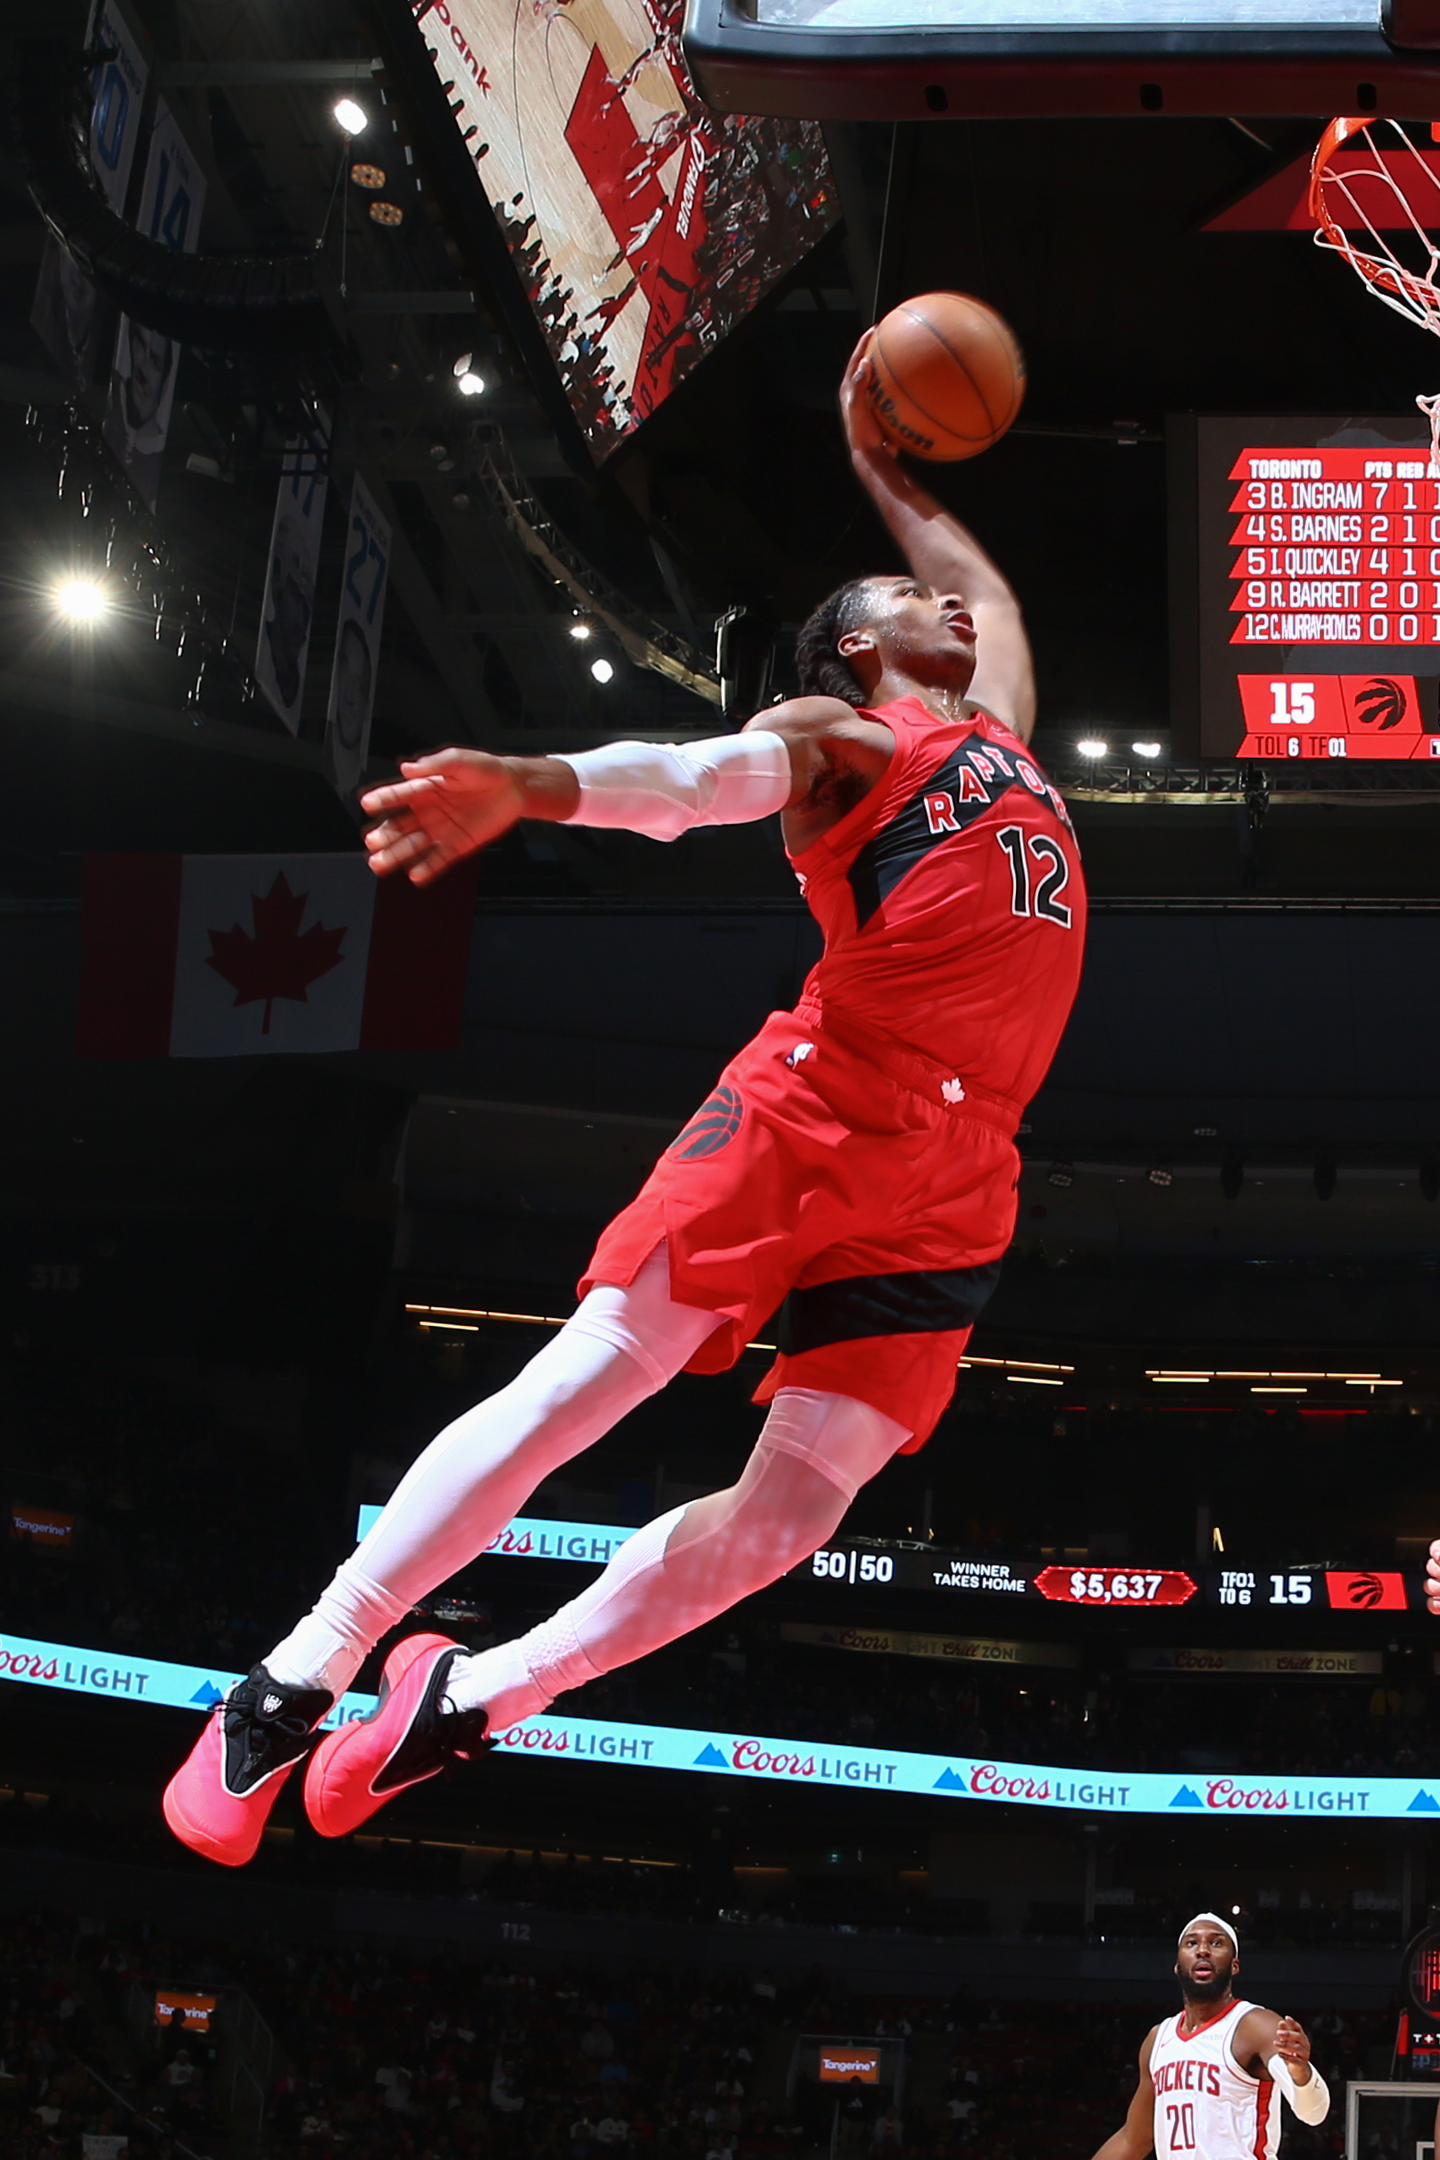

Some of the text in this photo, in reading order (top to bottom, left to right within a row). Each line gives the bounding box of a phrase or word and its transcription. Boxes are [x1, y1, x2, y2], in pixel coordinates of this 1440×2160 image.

[1249, 459, 1323, 479] TORONTO
[1364, 461, 1393, 479] PTS
[1397, 461, 1424, 479] REB
[1247, 482, 1266, 510] 3
[1271, 482, 1287, 510] B.
[1291, 482, 1363, 510] INGRAM
[1370, 482, 1388, 510] 7
[1402, 482, 1418, 510] 1
[1246, 515, 1266, 542] 4
[1270, 515, 1287, 542] S.
[1291, 515, 1362, 542] BARNES
[1370, 515, 1389, 542] 2
[1402, 515, 1418, 542] 1
[1248, 548, 1266, 575] 5
[1270, 548, 1284, 575] I.
[1285, 548, 1361, 579] QUICKLEY
[1369, 548, 1389, 575] 4
[1402, 548, 1417, 575] 1
[1247, 581, 1266, 608] 9
[1270, 581, 1286, 608] R.
[1289, 581, 1362, 608] BARRETT
[1370, 581, 1388, 608] 2
[1400, 581, 1418, 608] 0
[1245, 613, 1269, 640] 12
[1270, 613, 1280, 640] C.
[1369, 613, 1388, 640] 0
[1400, 613, 1418, 640] 0
[1269, 682, 1315, 724] 15
[1255, 736, 1284, 756] TOL
[1287, 737, 1300, 757] 6
[923, 745, 1074, 846] RAPTOR
[996, 825, 1072, 930] 12
[13, 1516, 66, 1536] Tangerine
[539, 1533, 624, 1561] LIGH
[933, 1572, 1026, 1592] TAKES HOME
[950, 1561, 1011, 1578] WINNER
[1070, 1571, 1163, 1603] $5,637
[1238, 1589, 1252, 1605] 6
[1268, 1575, 1313, 1604] 15
[838, 1629, 890, 1651] Coors
[942, 1643, 979, 1658] Chill
[0, 1648, 150, 1694] oors LIGHT
[1174, 1650, 1224, 1669] Coors
[1276, 1655, 1315, 1671] Chill
[1316, 1658, 1358, 1672] ZONE
[503, 1727, 655, 1761] oors LIGHT
[732, 1740, 898, 1785] Coors LIGHT
[970, 1764, 1131, 1807] Coors LIGHT
[1206, 1779, 1371, 1812] Coors LIGHT
[501, 1922, 531, 1940] 112
[823, 2058, 870, 2072] Tangerine
[1166, 2102, 1196, 2151] 20
